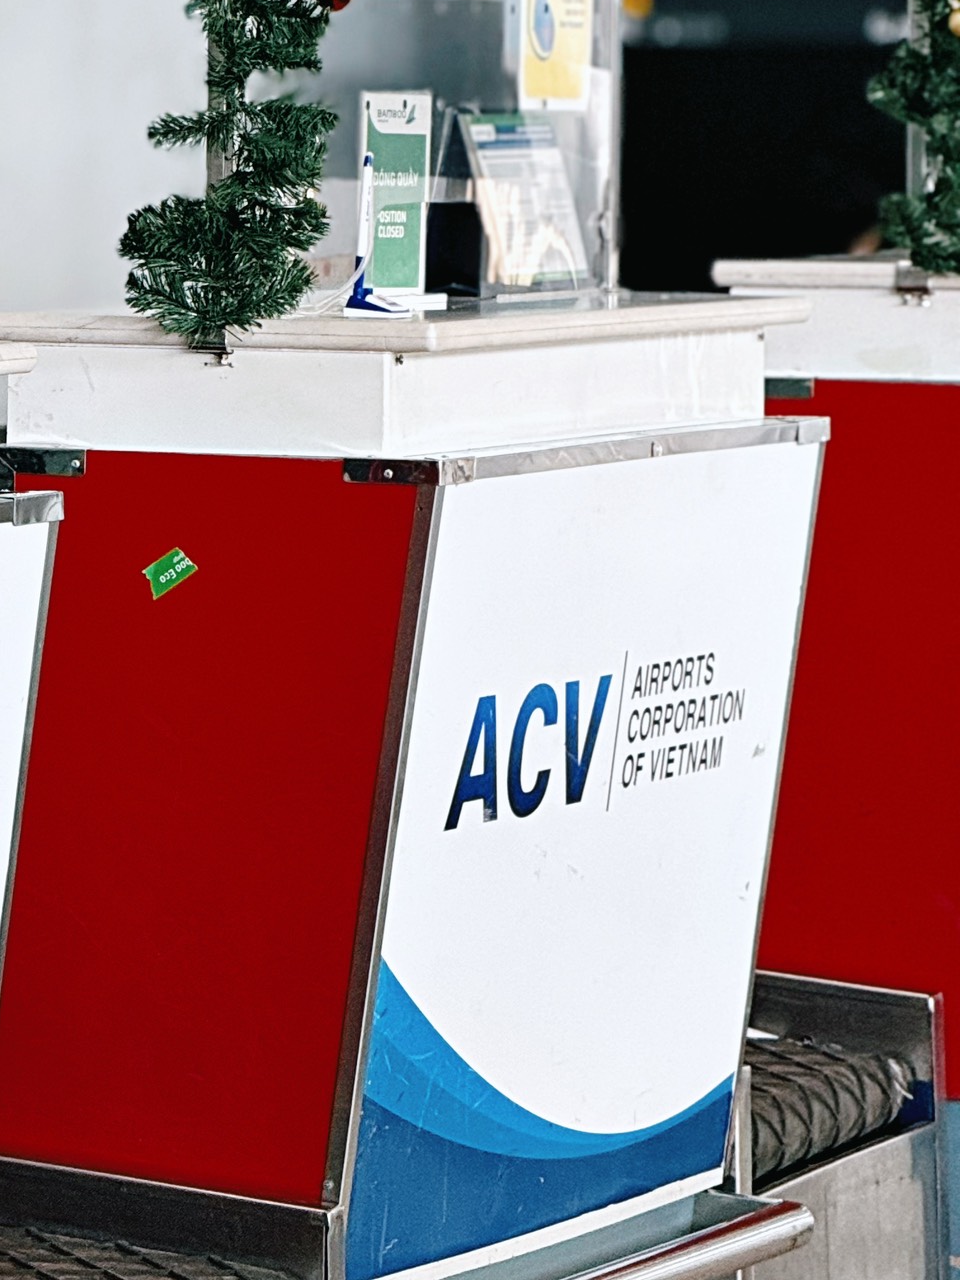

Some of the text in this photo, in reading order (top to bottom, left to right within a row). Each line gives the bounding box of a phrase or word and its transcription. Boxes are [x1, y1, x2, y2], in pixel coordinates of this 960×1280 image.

[377, 210, 406, 223] OSITION
[378, 225, 404, 238] CLOSED
[159, 568, 177, 583] Eco
[631, 652, 715, 700] AIRPORTS
[627, 688, 745, 743] CORPORATION
[443, 673, 613, 832] ACV
[622, 735, 724, 788] OF VIETNAM
